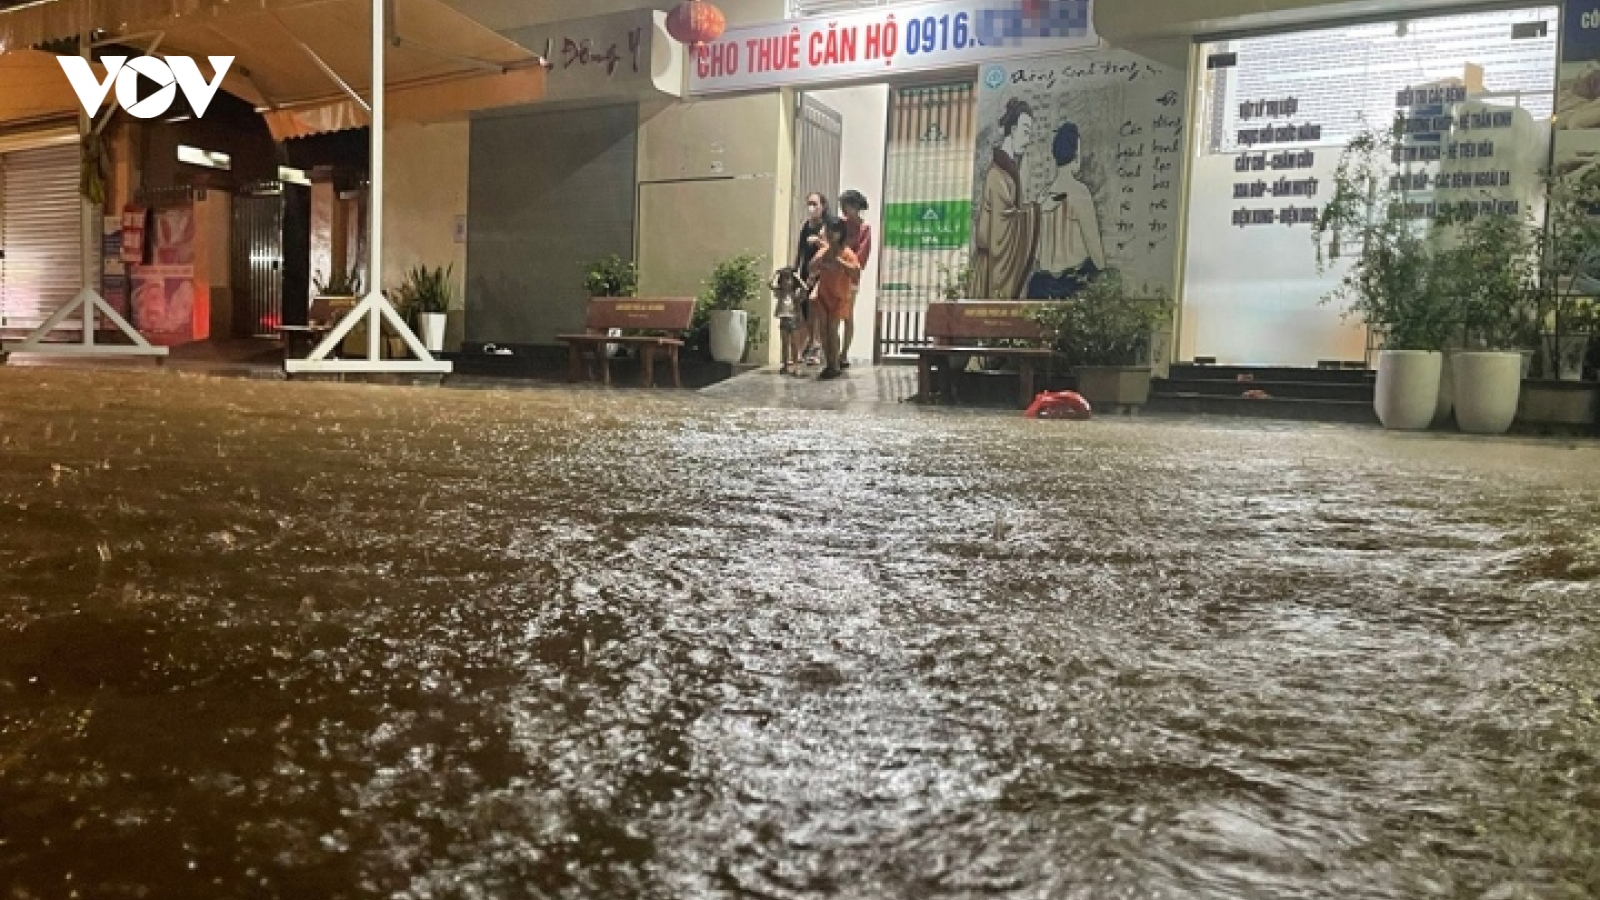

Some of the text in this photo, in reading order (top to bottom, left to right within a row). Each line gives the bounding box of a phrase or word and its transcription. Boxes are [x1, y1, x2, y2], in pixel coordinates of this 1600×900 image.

[697, 40, 738, 79] CHO
[746, 27, 800, 73] THUÊ
[808, 21, 857, 67] CĂN
[864, 13, 899, 67] HỘ
